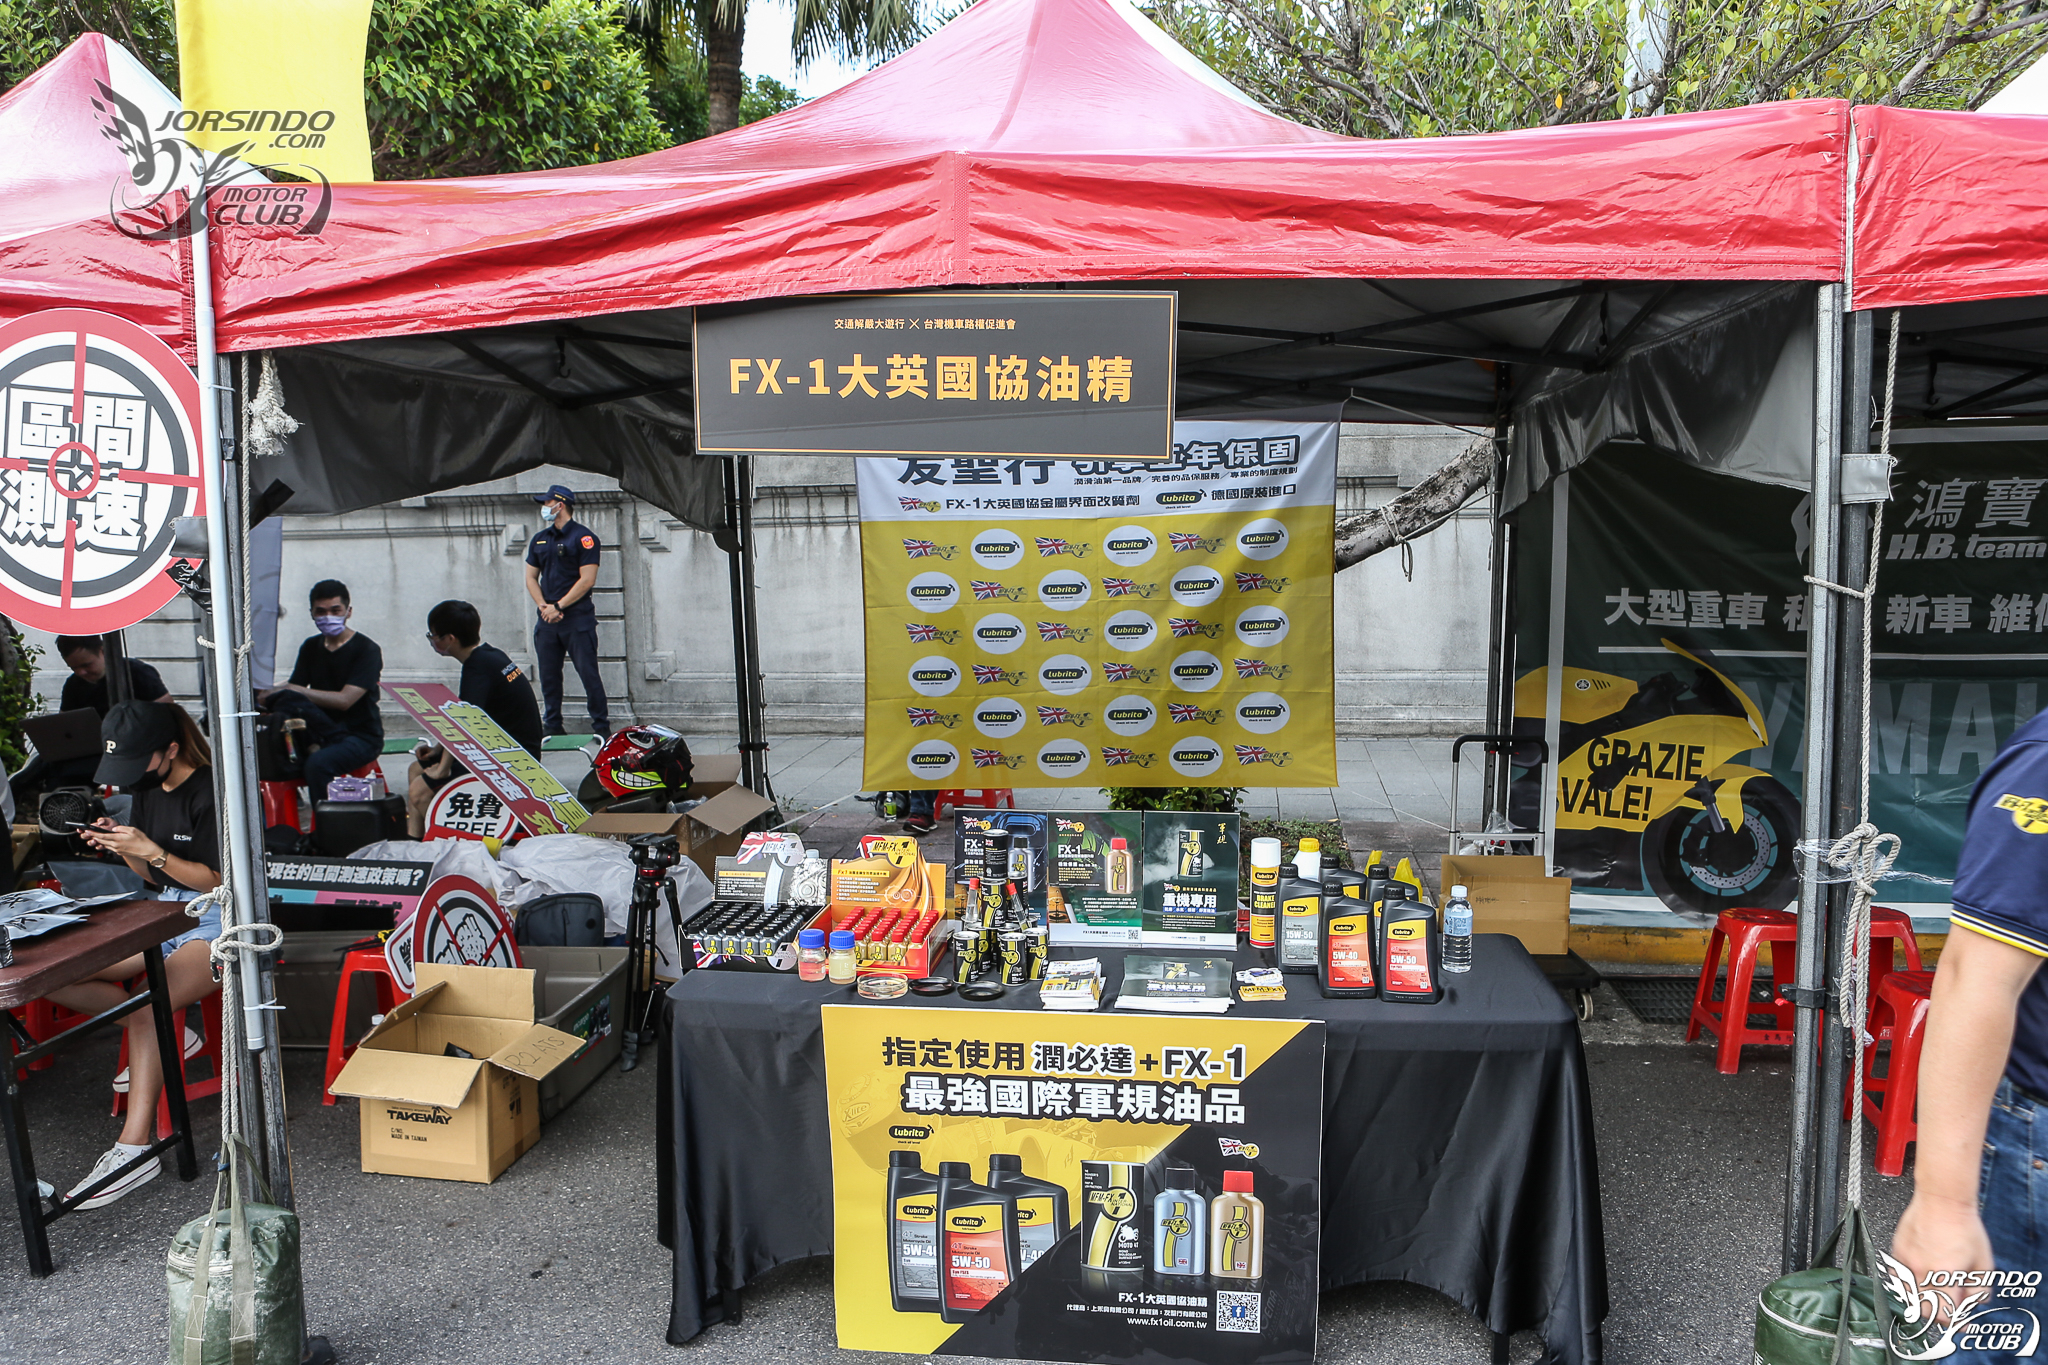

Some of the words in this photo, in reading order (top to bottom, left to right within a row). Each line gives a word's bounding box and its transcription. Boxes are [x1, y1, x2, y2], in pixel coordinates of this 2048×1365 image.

[924, 318, 1017, 330] 台灣機車路權促進會
[729, 353, 1134, 403] FX-1大英國協油精
[1161, 494, 1196, 504] Lubrita
[1211, 484, 1297, 501] 德國原裝進口
[1904, 476, 2045, 530] 鴻寶
[1886, 533, 1957, 560] H.B.
[1964, 533, 2047, 560] team
[1180, 582, 1209, 590] Lubrita
[1604, 587, 1768, 630] 大型重車
[1886, 594, 1972, 634] 新車
[1114, 626, 1142, 634] Lubrita
[1245, 622, 1275, 630] Lubrita
[1048, 670, 1077, 678] Lubrita
[1246, 708, 1275, 716] Lubrita
[105, 740, 117, 754] P
[1586, 736, 1705, 782] GRAZIE
[446, 792, 504, 820] 免費
[1057, 844, 1081, 856] FX-1
[266, 861, 425, 887] 現在的區間測速政策嗎?
[1162, 892, 1217, 909] 重機專用
[1286, 931, 1314, 940] 15W-50
[1332, 951, 1359, 960] 5W-40
[1390, 955, 1417, 965] 5W-50
[881, 1036, 1025, 1071] 指定使用
[1033, 1043, 1133, 1075] 潤必達
[1163, 1046, 1243, 1079] FX-1
[904, 1074, 1247, 1126] 最強國際軍規油品
[386, 1108, 453, 1125] TAKEWAY
[894, 1128, 925, 1138] Lubrita
[951, 1255, 991, 1269] 5W-50
[1118, 1292, 1208, 1308] FX-1大英國協油精
[1127, 1317, 1207, 1329] www.fx1oil.com.tw
